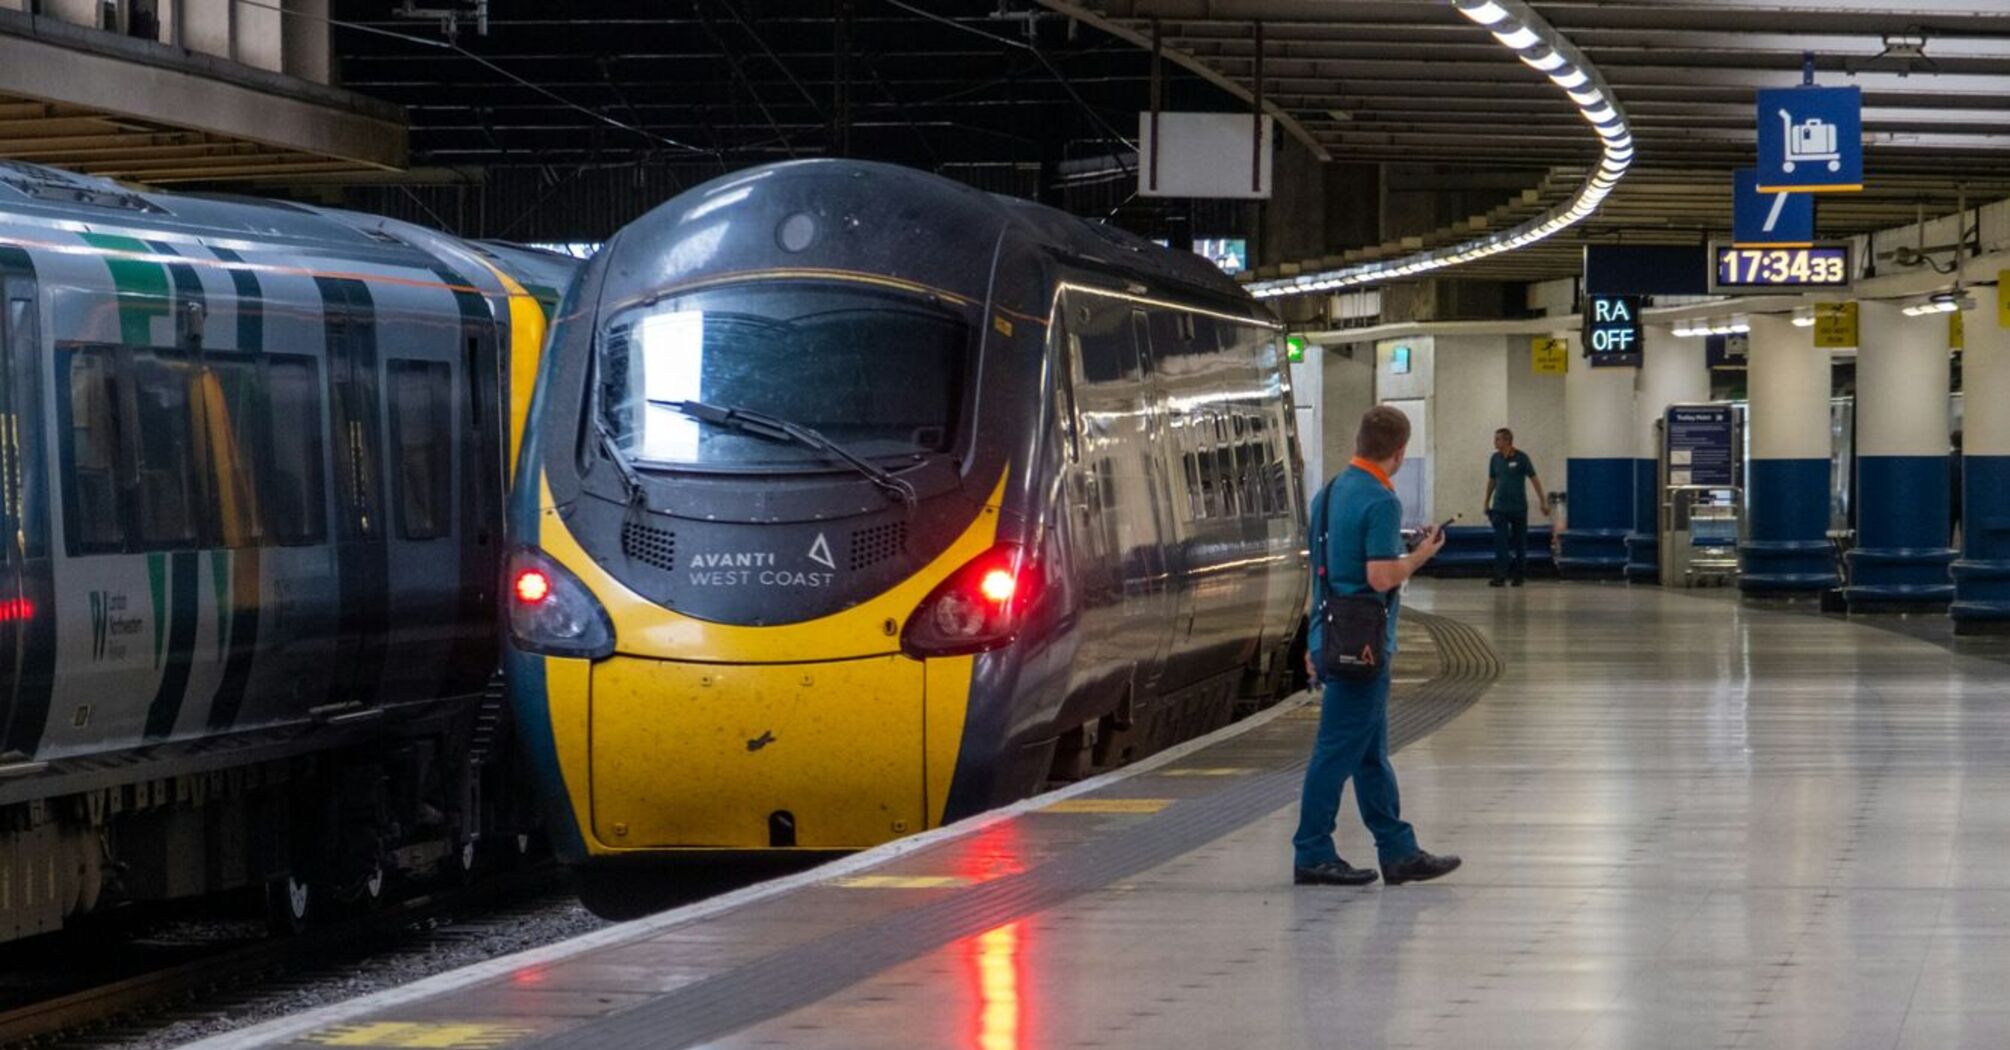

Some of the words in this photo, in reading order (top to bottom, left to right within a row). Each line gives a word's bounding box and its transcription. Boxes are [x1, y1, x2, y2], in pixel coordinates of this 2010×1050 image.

[1594, 300, 1630, 322] RA
[1592, 328, 1635, 351] OFF
[689, 552, 775, 568] AVANTI
[689, 571, 750, 586] WEST
[759, 571, 835, 587] COAST
